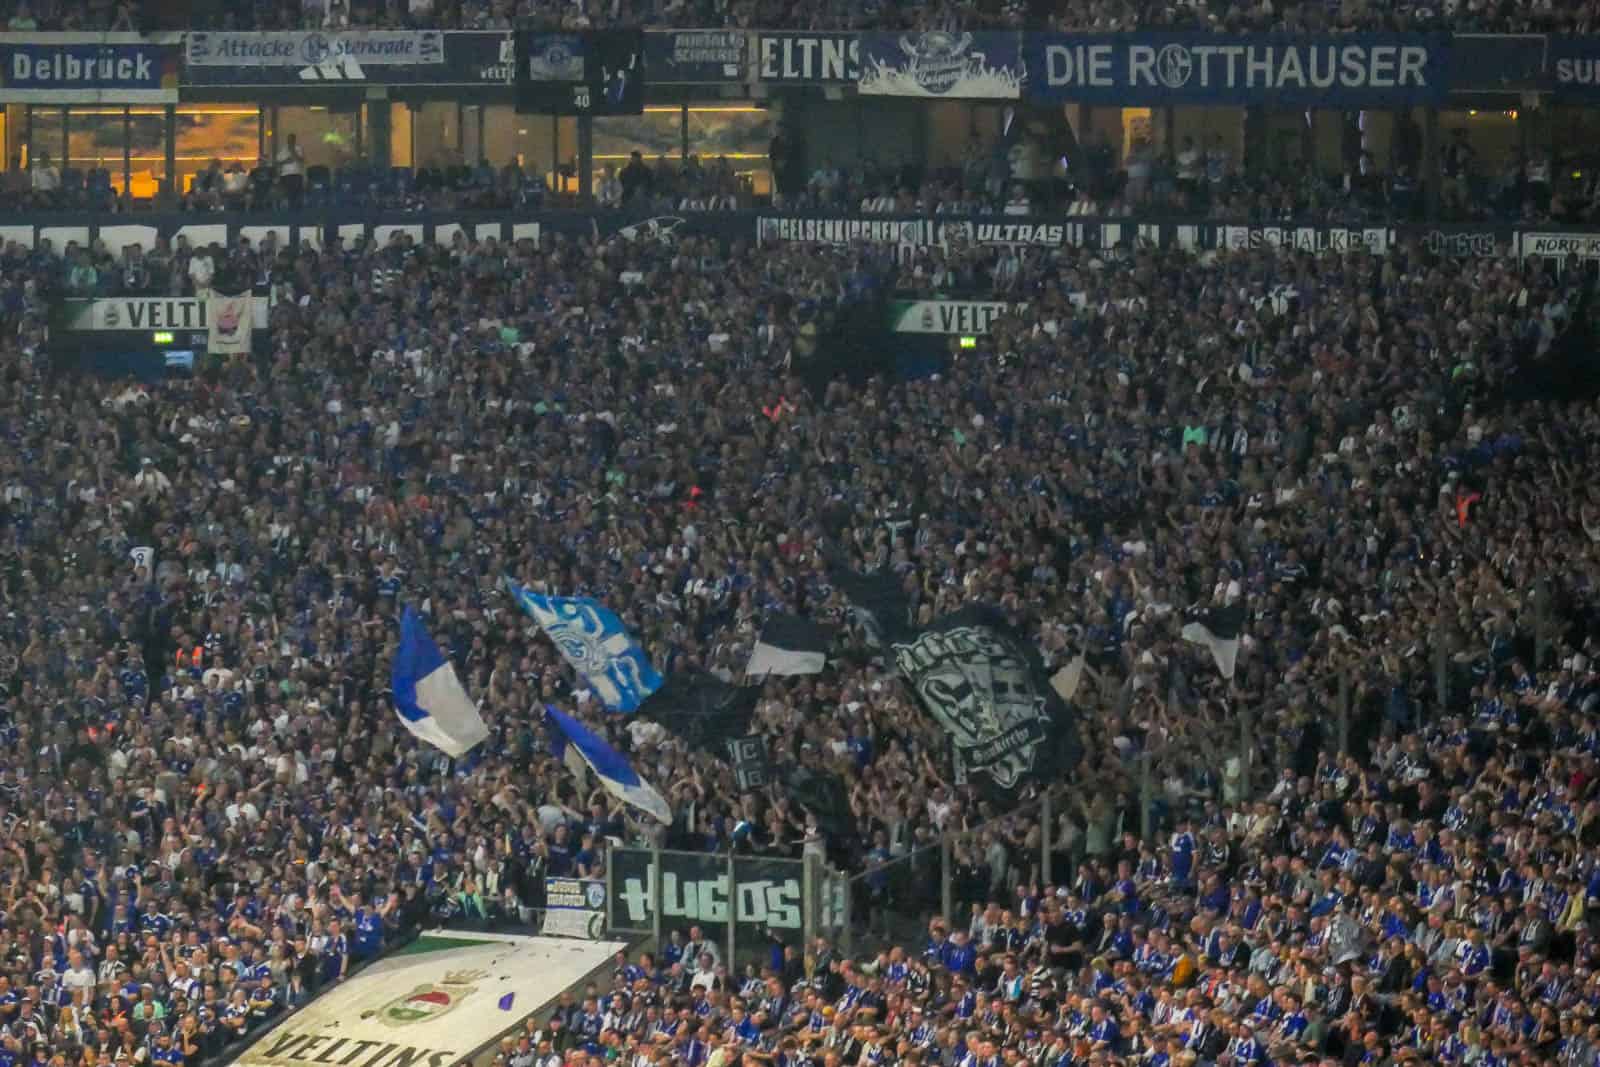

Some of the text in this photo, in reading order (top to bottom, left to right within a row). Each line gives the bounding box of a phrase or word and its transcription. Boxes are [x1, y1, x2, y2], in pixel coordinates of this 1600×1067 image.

[215, 38, 296, 57] Attacke
[13, 49, 153, 81] Delbrück
[1045, 45, 1114, 86] DIE
[977, 223, 1064, 242] ULTRAS
[620, 864, 801, 929] HUGOS
